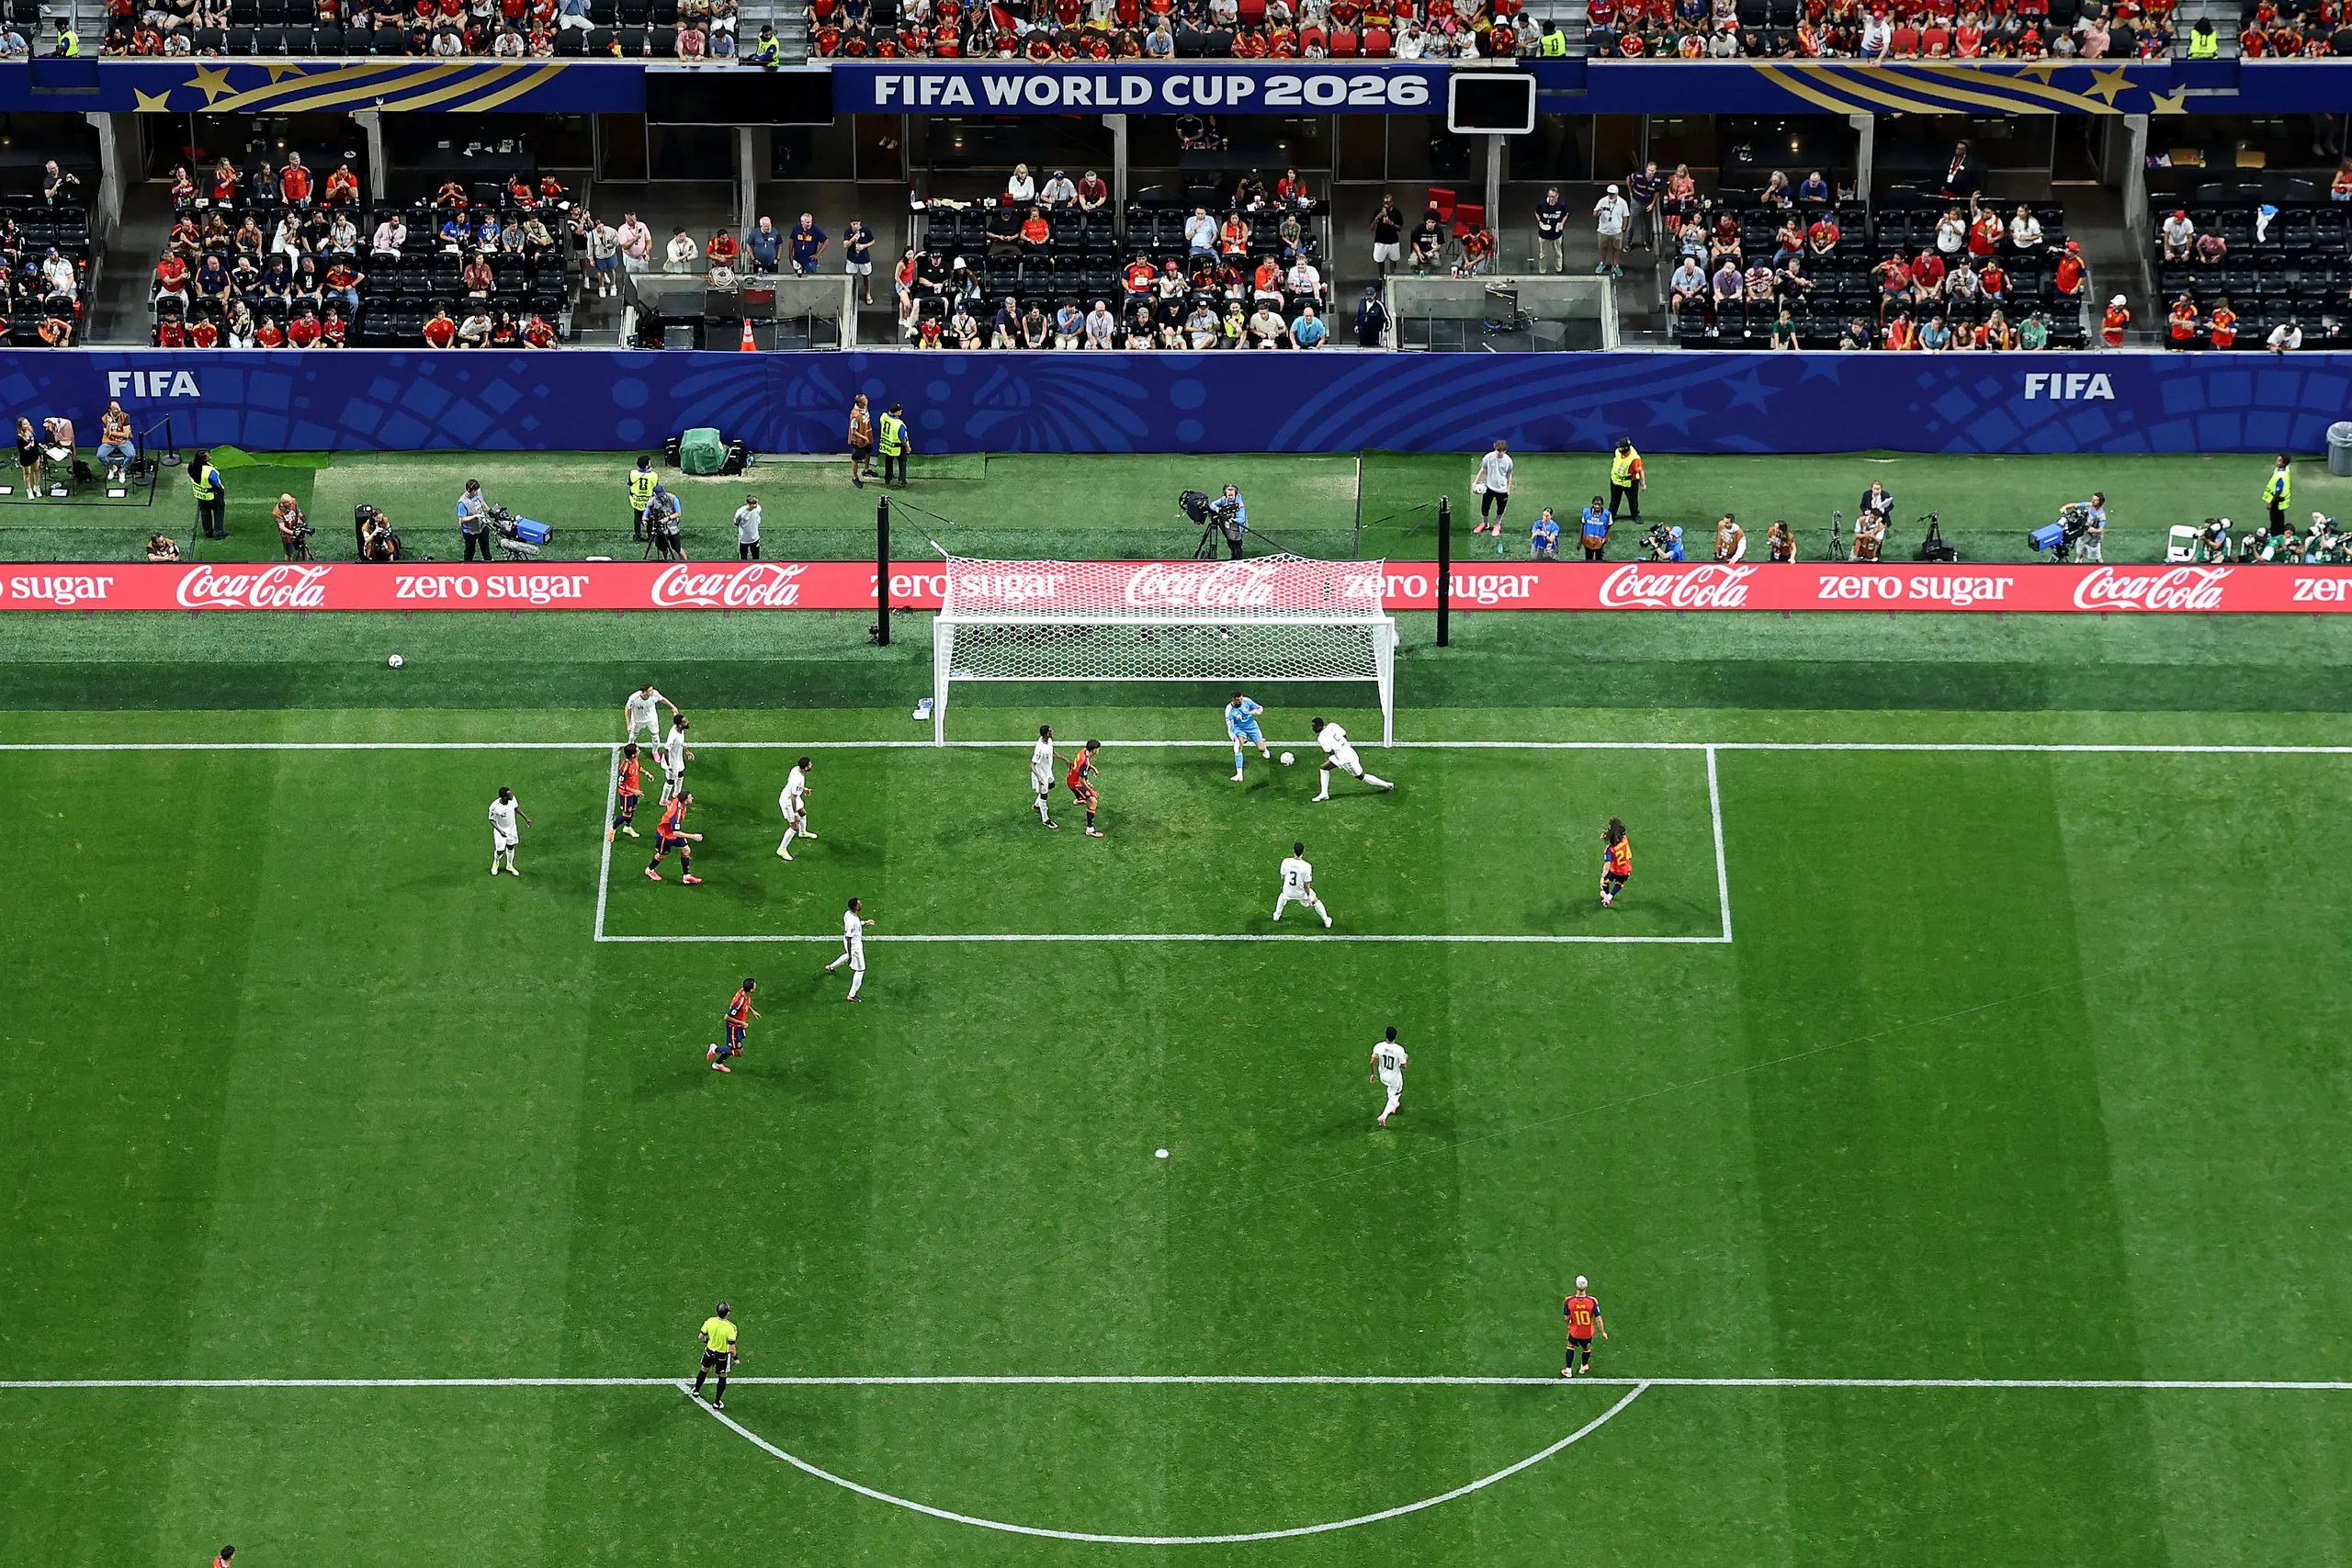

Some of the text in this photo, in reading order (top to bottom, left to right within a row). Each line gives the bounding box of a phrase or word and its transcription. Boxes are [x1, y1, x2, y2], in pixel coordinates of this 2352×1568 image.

[875, 75, 1431, 106] FIFA WORLD CUP 2026
[107, 371, 201, 398] FIFA
[2024, 373, 2116, 400] FIFA
[10, 576, 114, 605] sugar
[175, 565, 334, 608] Coca-Cola
[395, 575, 590, 604] zero sugar
[650, 564, 808, 607] Coca-Cola
[1343, 575, 1428, 598] zero
[1599, 564, 1759, 608] Coca-Cola
[1817, 576, 2014, 606] zero sugar
[2073, 566, 2235, 610] Coca-Cola
[1288, 871, 1297, 886] 3
[1382, 1054, 1396, 1071] 10
[1574, 1310, 1591, 1326] 10
